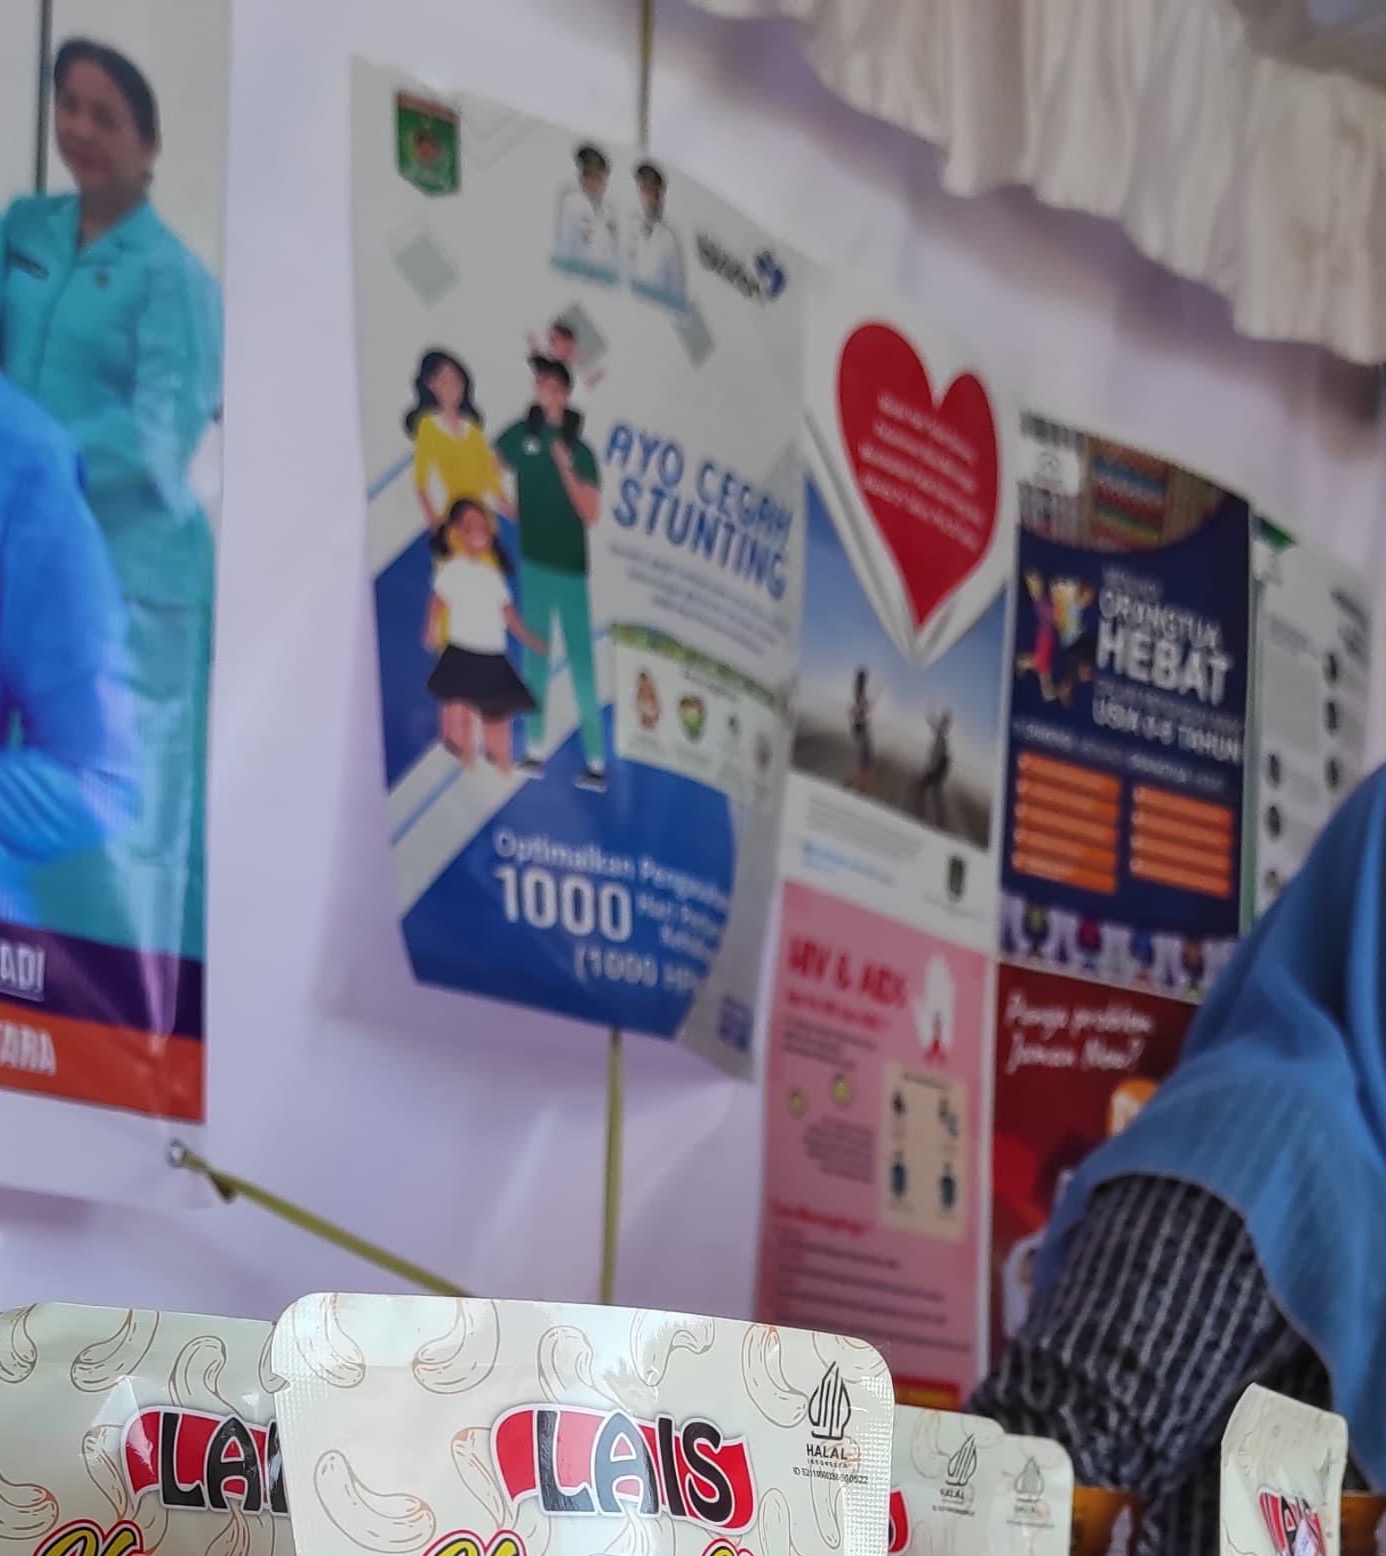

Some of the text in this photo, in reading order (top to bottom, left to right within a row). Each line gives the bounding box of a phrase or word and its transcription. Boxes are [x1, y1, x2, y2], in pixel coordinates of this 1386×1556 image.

[604, 423, 684, 487] AYO
[696, 462, 793, 538] CEGAH
[613, 478, 787, 600] STUNTING
[1096, 620, 1233, 704] HEBAT
[493, 863, 633, 944] 1000
[159, 1411, 288, 1515] LAI
[537, 1410, 740, 1525] LAIS
[806, 1444, 849, 1461] HALAL
